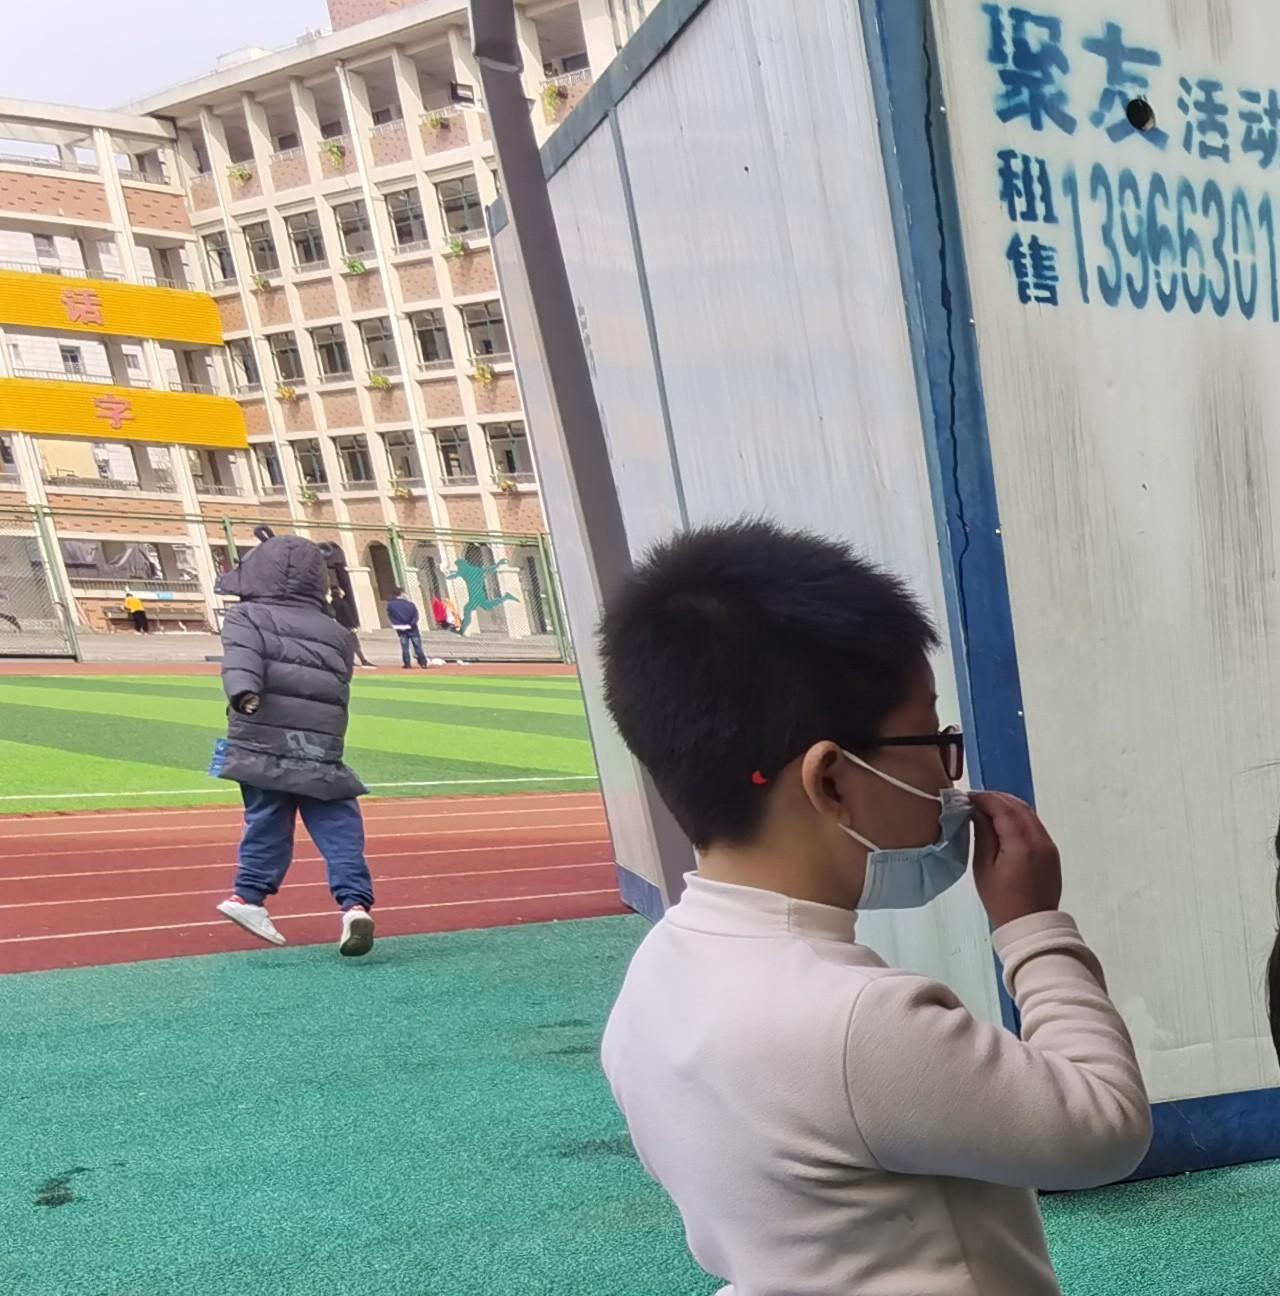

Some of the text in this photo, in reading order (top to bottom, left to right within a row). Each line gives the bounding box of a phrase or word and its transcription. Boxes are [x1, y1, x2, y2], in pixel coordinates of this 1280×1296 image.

[997, 148, 1060, 306] 租售
[60, 287, 106, 327] 话
[93, 393, 136, 430] 字
